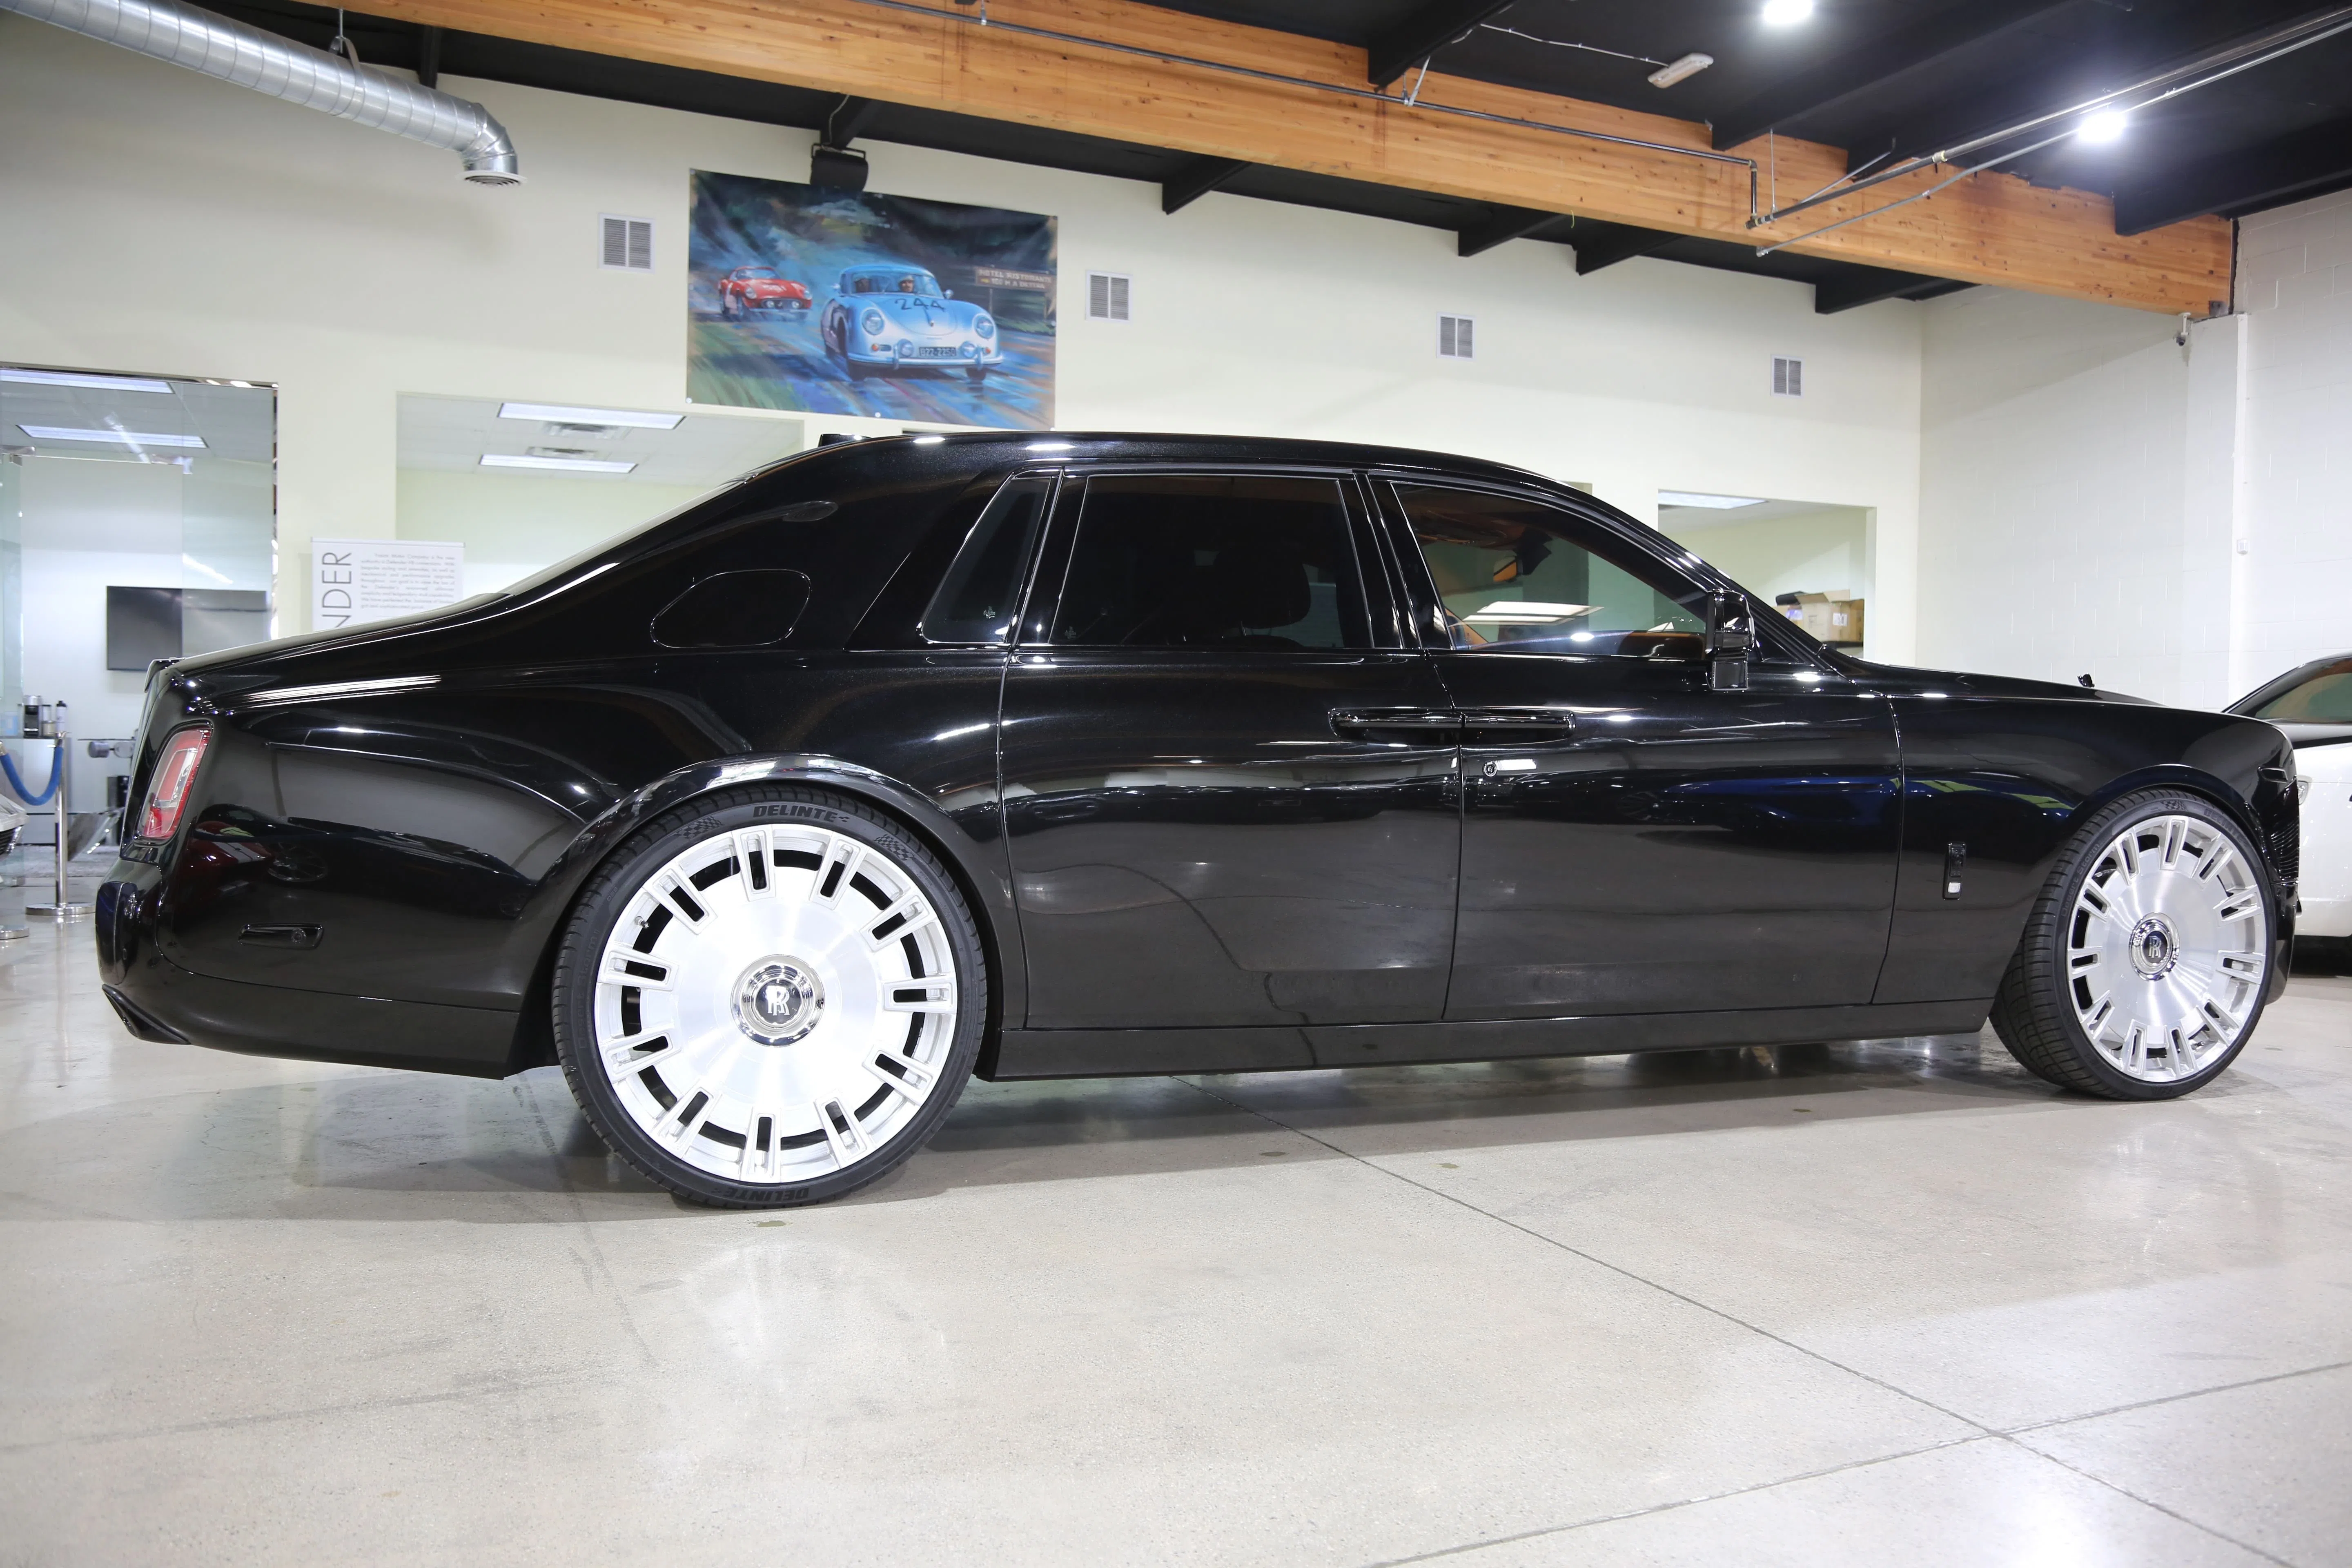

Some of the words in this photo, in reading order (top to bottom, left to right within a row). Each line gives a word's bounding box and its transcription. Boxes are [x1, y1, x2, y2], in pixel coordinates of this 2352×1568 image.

[894, 298, 946, 312] 244
[753, 805, 838, 822] DELINTE
[724, 1187, 809, 1201] DELINTE
